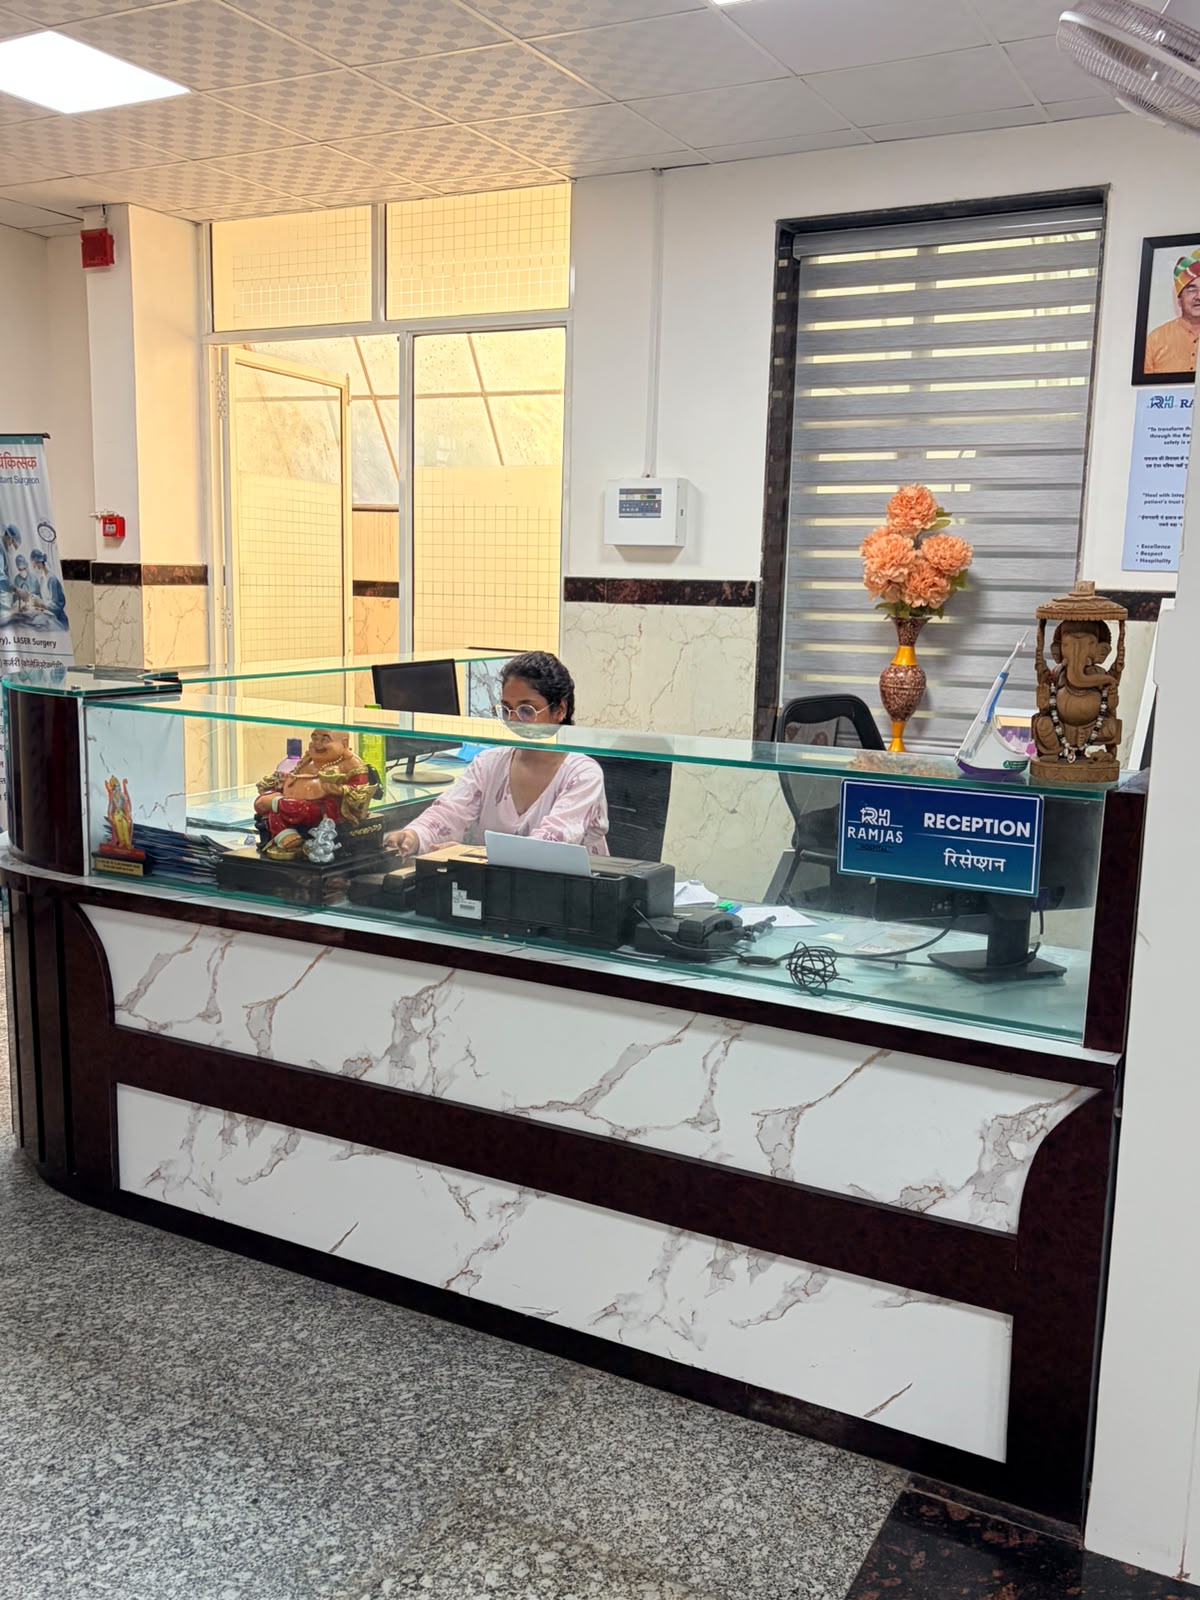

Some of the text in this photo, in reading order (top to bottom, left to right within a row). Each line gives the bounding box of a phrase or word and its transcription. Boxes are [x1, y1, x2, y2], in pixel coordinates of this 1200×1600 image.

[13, 475, 40, 486] Surgeon
[13, 636, 31, 645] LASER
[32, 637, 57, 648] Surgery
[923, 812, 1031, 838] RECEPTION
[847, 826, 903, 844] RAMJAS
[943, 847, 1006, 872] रिसेप्शन
